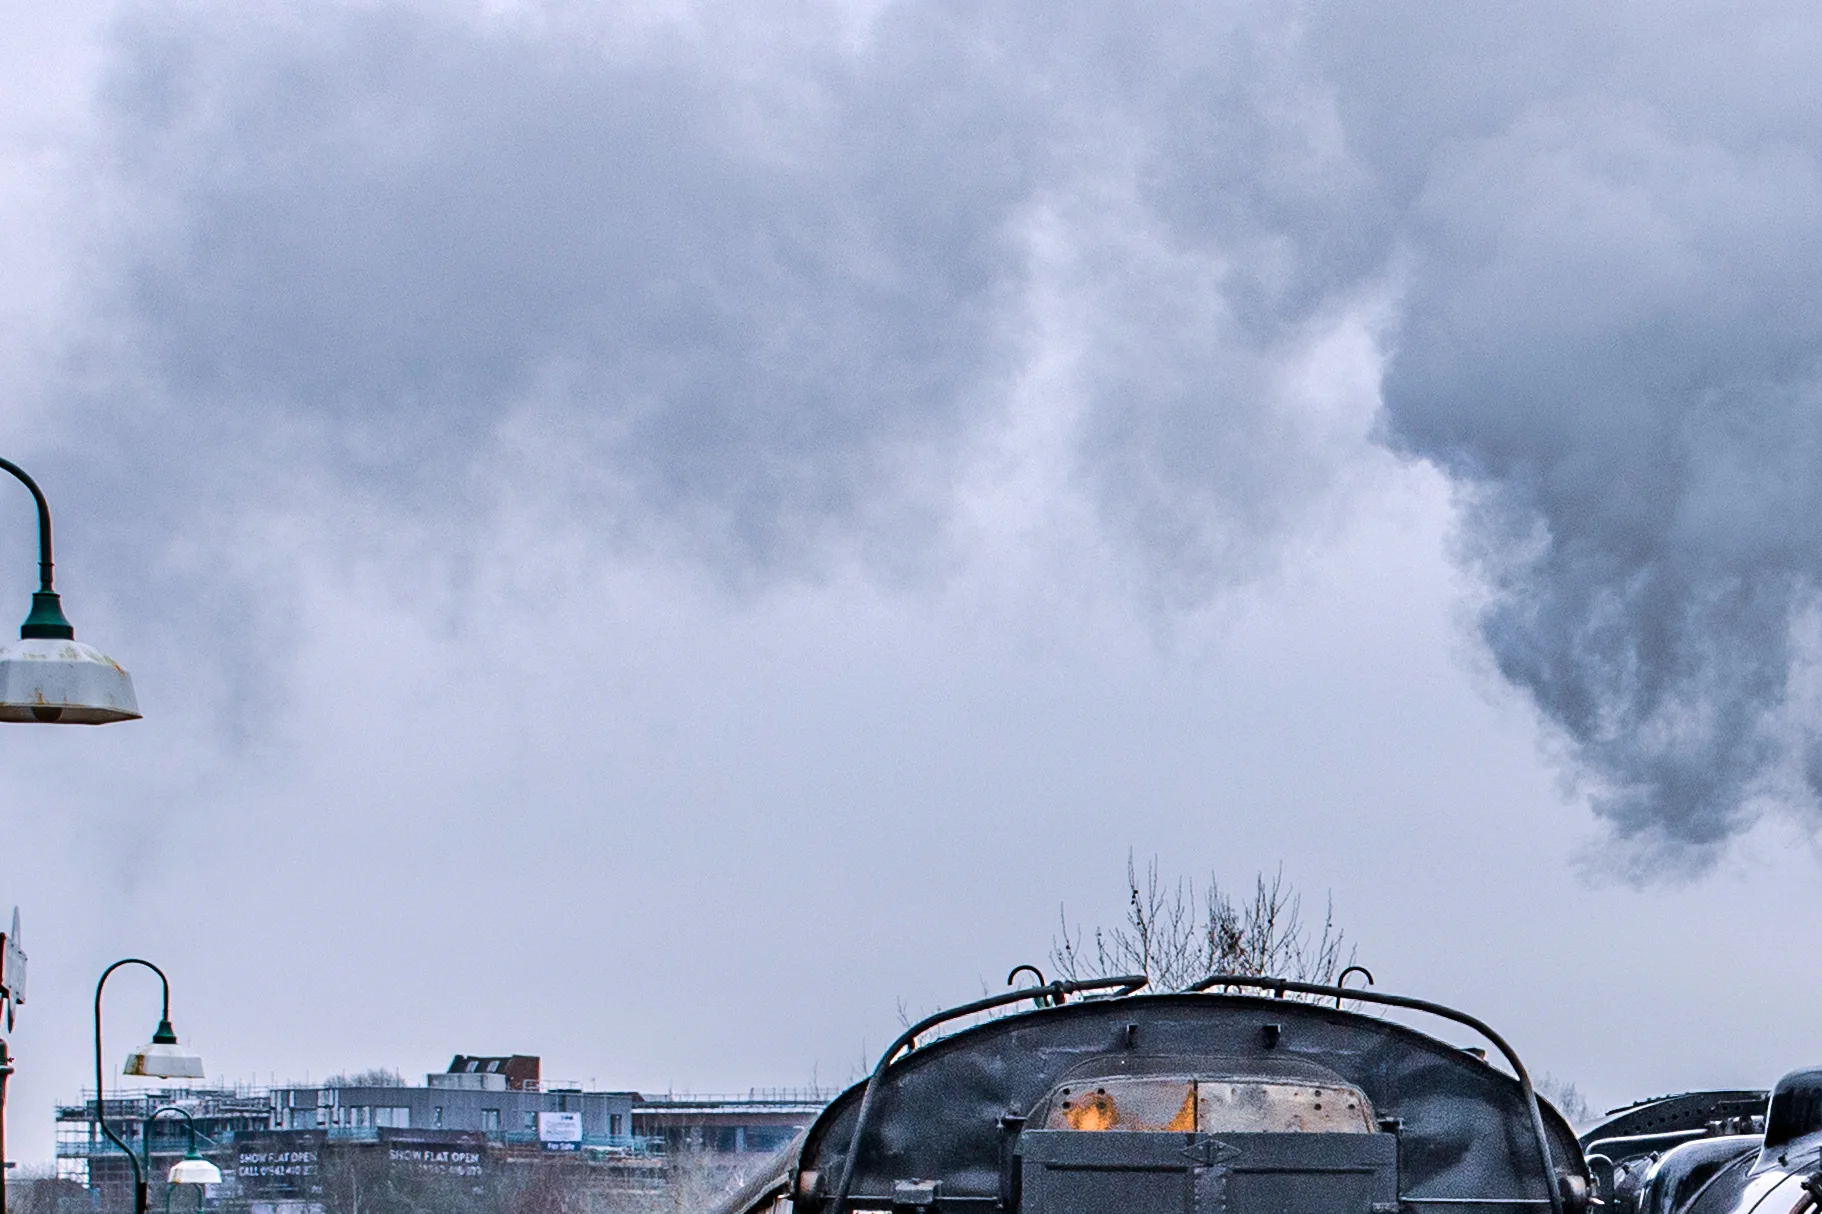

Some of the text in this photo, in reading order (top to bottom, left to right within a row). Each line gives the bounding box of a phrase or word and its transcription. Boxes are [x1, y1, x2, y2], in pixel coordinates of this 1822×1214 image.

[239, 1152, 267, 1163] SHOW
[290, 1151, 318, 1163] OPEN
[389, 1149, 480, 1164] SHOW FLAT OPEN
[238, 1165, 259, 1177] CALL
